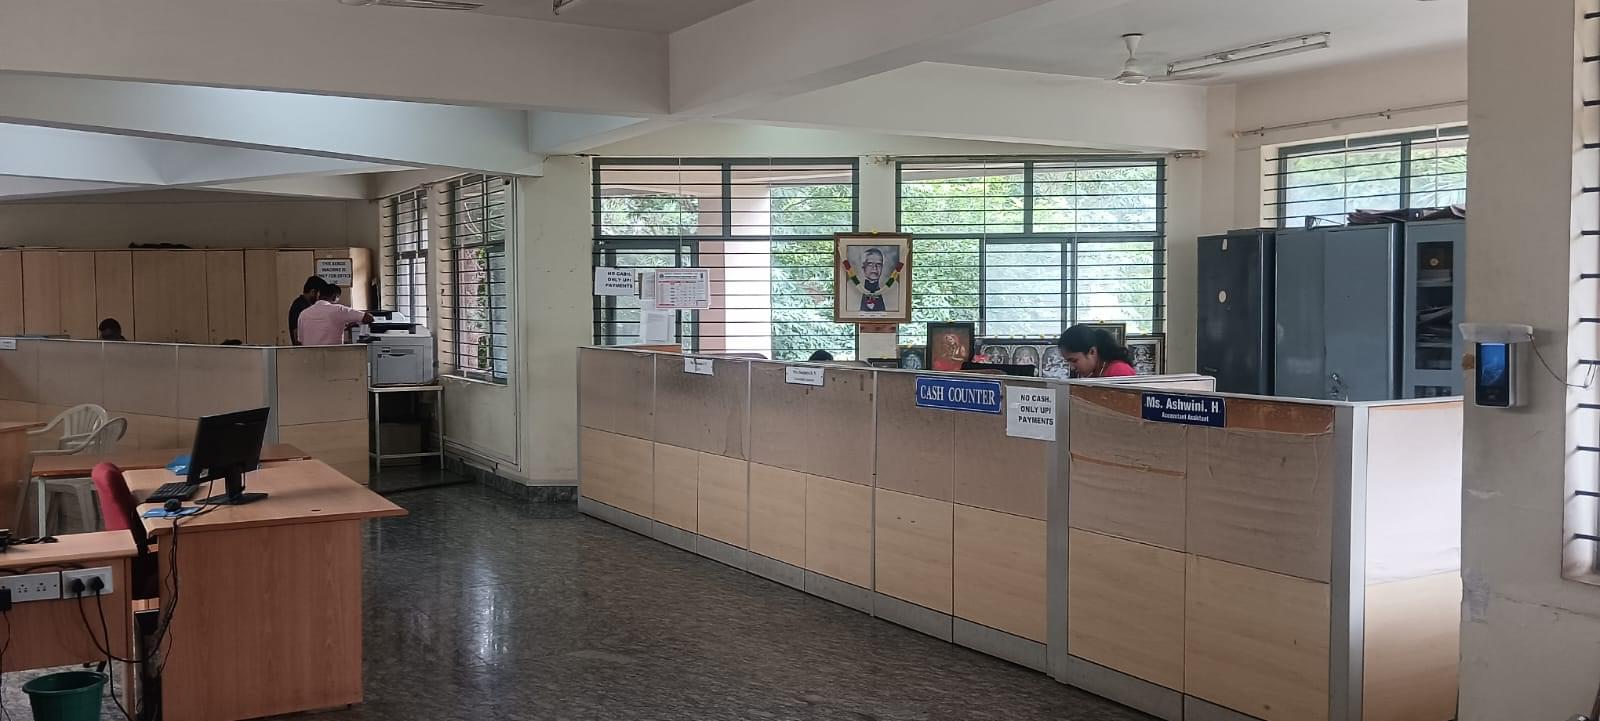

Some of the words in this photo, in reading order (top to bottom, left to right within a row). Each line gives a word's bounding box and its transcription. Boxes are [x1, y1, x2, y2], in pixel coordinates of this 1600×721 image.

[920, 384, 944, 401] CASH
[948, 386, 995, 405] COUNTER
[1020, 394, 1030, 402] NO
[1020, 405, 1039, 413] ONLY
[1146, 396, 1163, 409] Ms.
[1211, 401, 1219, 413] H
[1018, 415, 1054, 426] PAYMENTS
[1161, 411, 1187, 420] Accountant
[1187, 413, 1209, 422] Assistant
